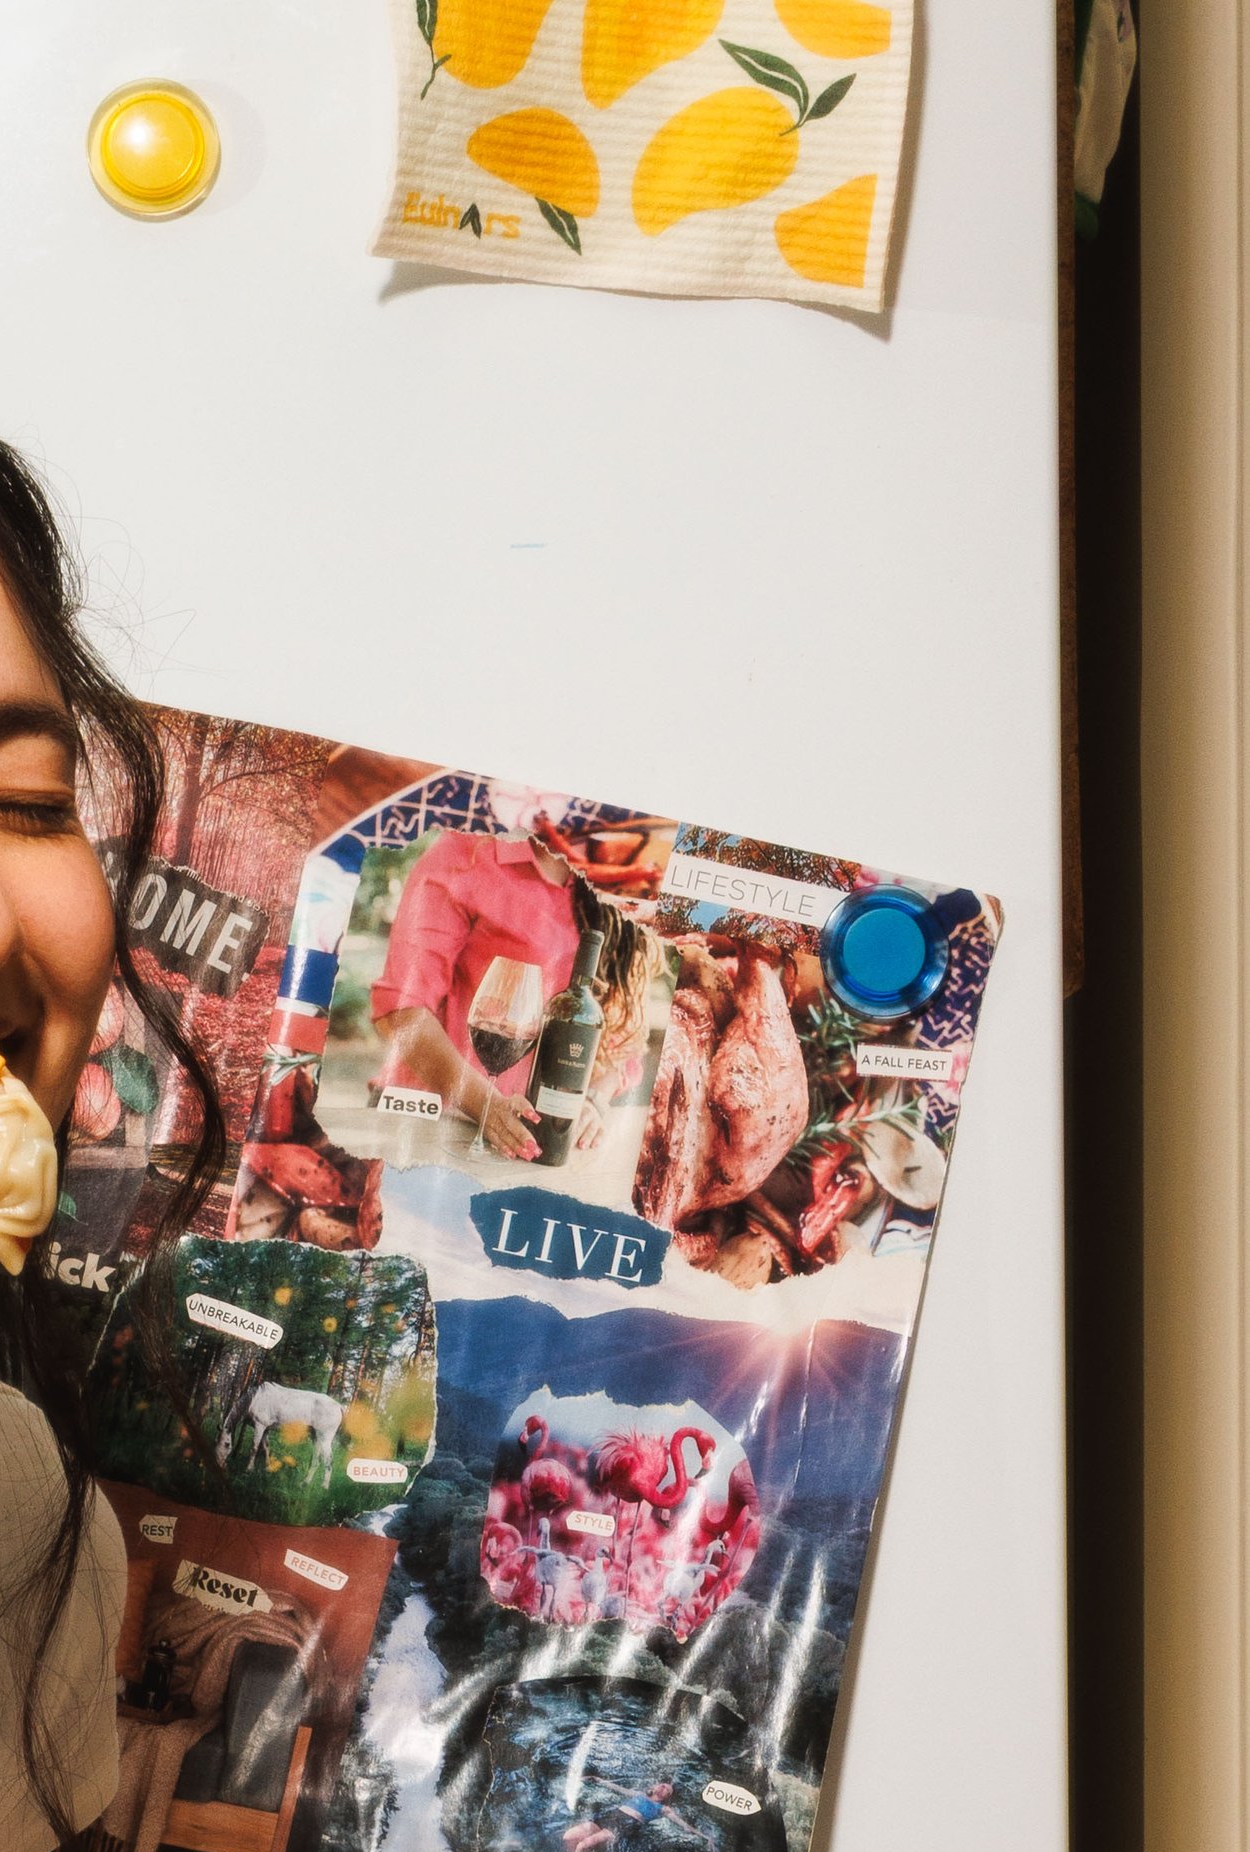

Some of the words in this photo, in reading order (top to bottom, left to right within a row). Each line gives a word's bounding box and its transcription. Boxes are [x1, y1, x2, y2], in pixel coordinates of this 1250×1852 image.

[670, 864, 817, 918] LIFESTYLE
[861, 1054, 871, 1066] A
[874, 1055, 904, 1069] FALL
[907, 1058, 948, 1072] FEAST
[382, 1095, 439, 1115] Taste
[491, 1208, 647, 1283] LIVE
[188, 1299, 279, 1341] UNBREAKABLE
[353, 1466, 405, 1477] BEAUTY
[141, 1524, 174, 1538] REST
[574, 1513, 614, 1531] STYLE
[290, 1555, 345, 1586] REFLECT
[190, 1566, 259, 1608] Reset
[706, 1786, 753, 1812] POWER
